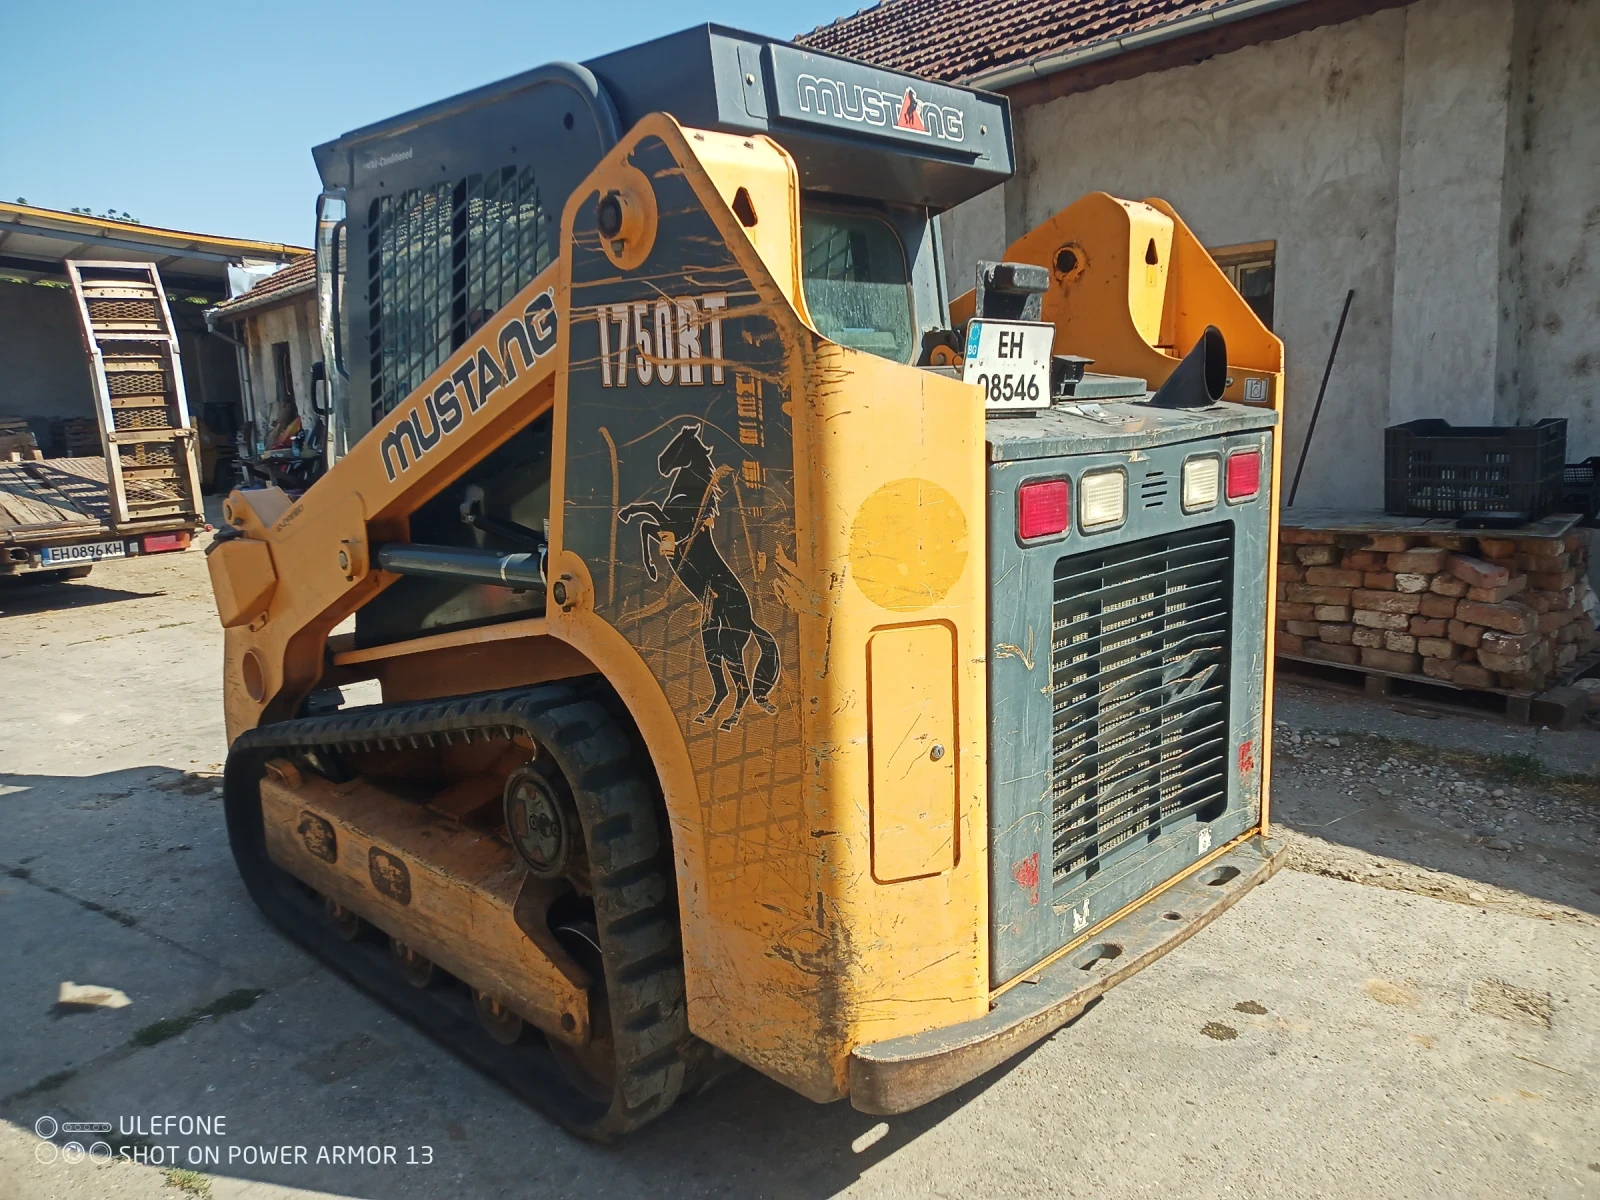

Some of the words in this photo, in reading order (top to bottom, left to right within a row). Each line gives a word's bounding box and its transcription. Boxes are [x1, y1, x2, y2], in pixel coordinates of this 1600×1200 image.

[797, 73, 965, 142] MUSTANG
[597, 291, 728, 388] 1750RT
[967, 344, 978, 355] BG
[998, 331, 1024, 358] EH
[380, 291, 559, 484] MUSTANG
[51, 547, 70, 561] EH
[71, 545, 103, 559] 0896
[104, 542, 122, 555] KH
